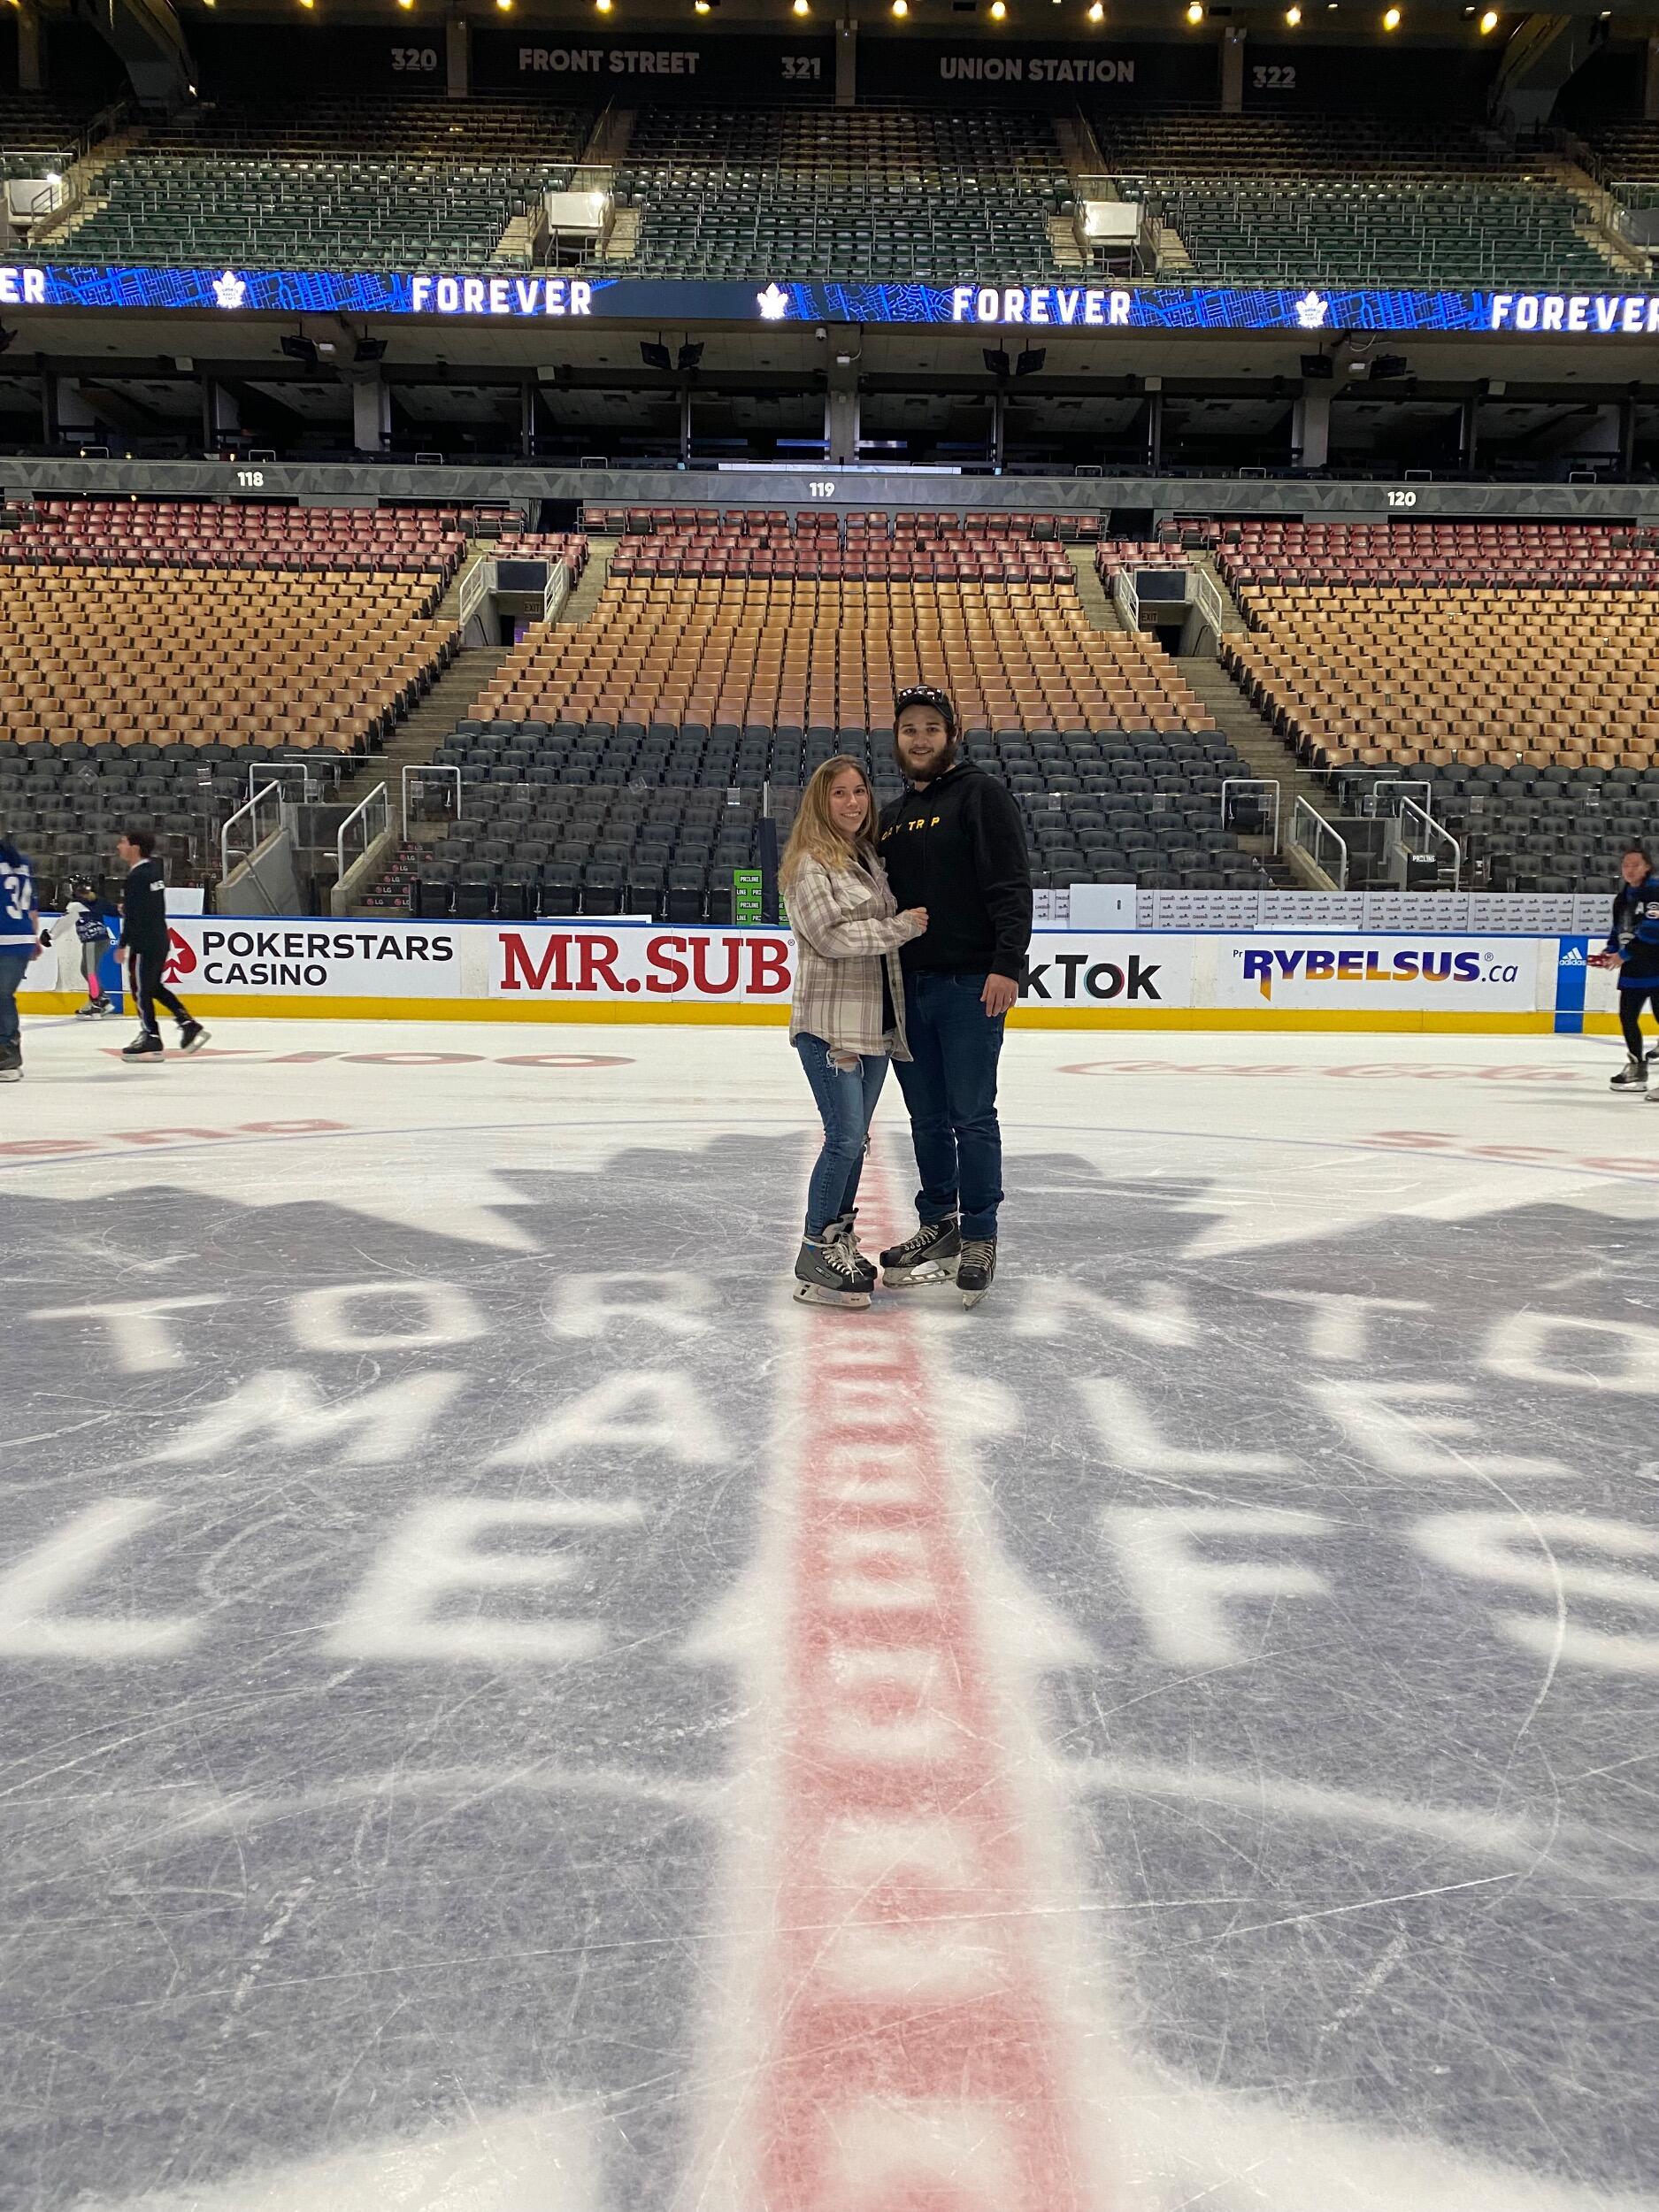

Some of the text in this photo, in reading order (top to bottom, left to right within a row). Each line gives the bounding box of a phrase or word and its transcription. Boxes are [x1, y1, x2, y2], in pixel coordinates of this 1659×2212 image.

[391, 48, 437, 71] 320
[518, 48, 700, 74] FRONT STREET
[781, 56, 821, 80] 321
[940, 57, 1134, 82] UNION STATION
[1253, 65, 1296, 88] 322
[0, 268, 44, 303] ER
[413, 277, 592, 315] FOREVER
[953, 287, 1132, 326] FOREVER
[237, 471, 264, 487] 118
[809, 482, 835, 497] 119
[1387, 491, 1417, 507] 120
[524, 603, 540, 612] EXIT
[1141, 612, 1157, 622] EXIT
[908, 816, 941, 832] TRP
[203, 931, 454, 962] POKERSTARS
[204, 962, 327, 987] CASINO
[25, 1271, 1659, 1392] TORNTO
